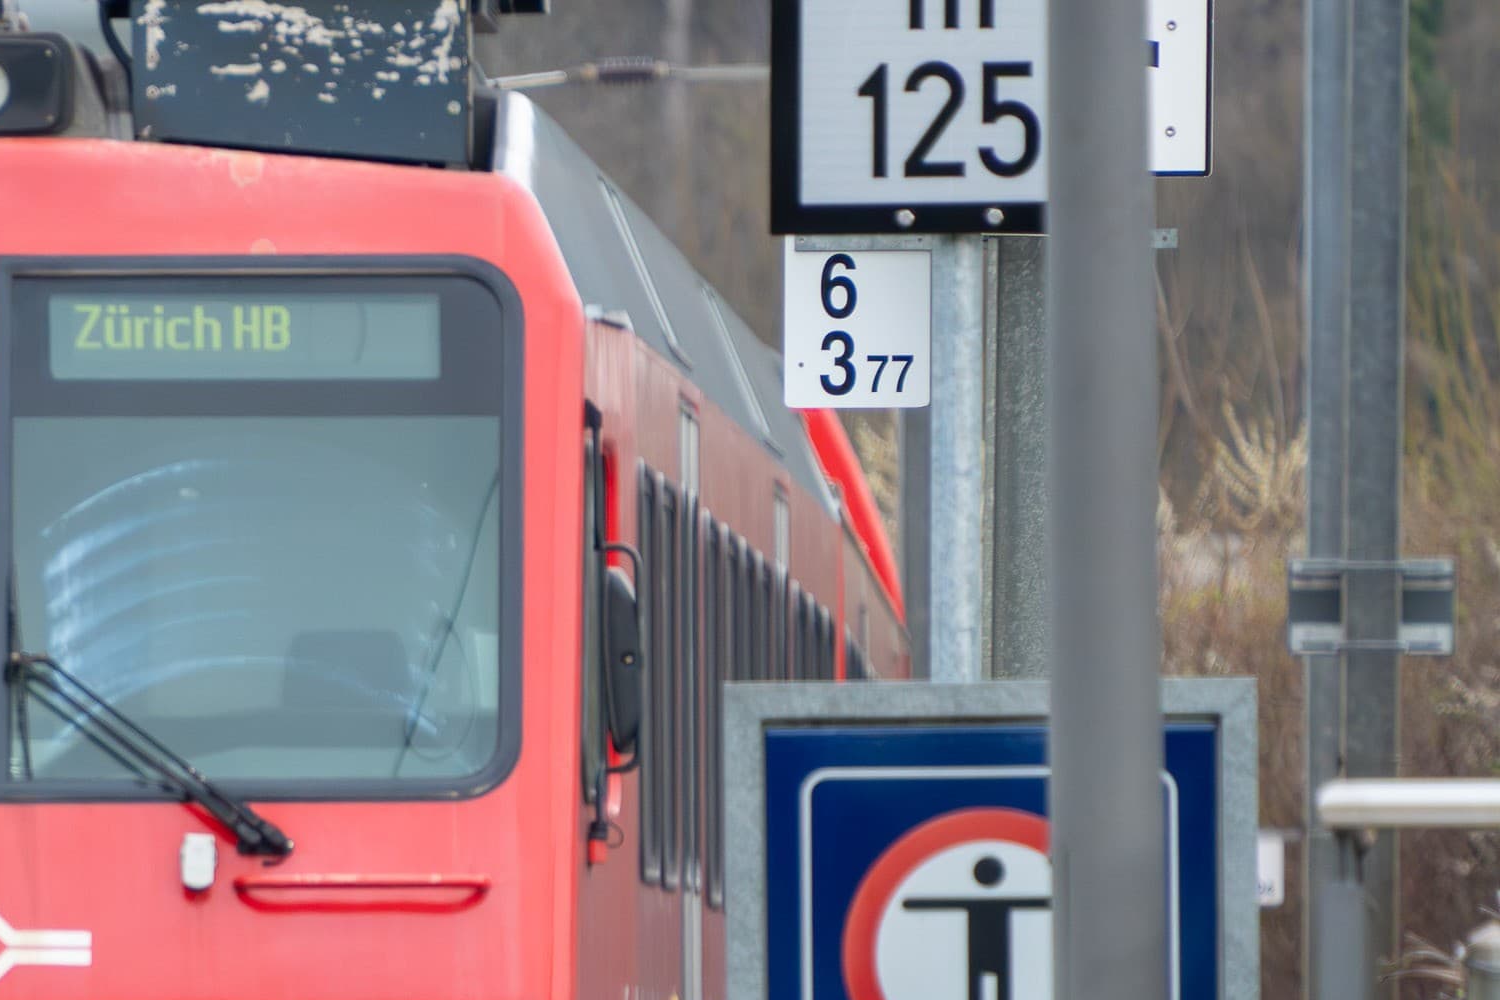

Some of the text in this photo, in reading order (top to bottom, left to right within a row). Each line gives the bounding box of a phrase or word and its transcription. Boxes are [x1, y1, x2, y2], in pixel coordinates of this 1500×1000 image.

[856, 59, 1042, 179] 125
[819, 252, 858, 320] 6
[73, 303, 291, 351] Zürich HB
[818, 330, 915, 397] 3 77
